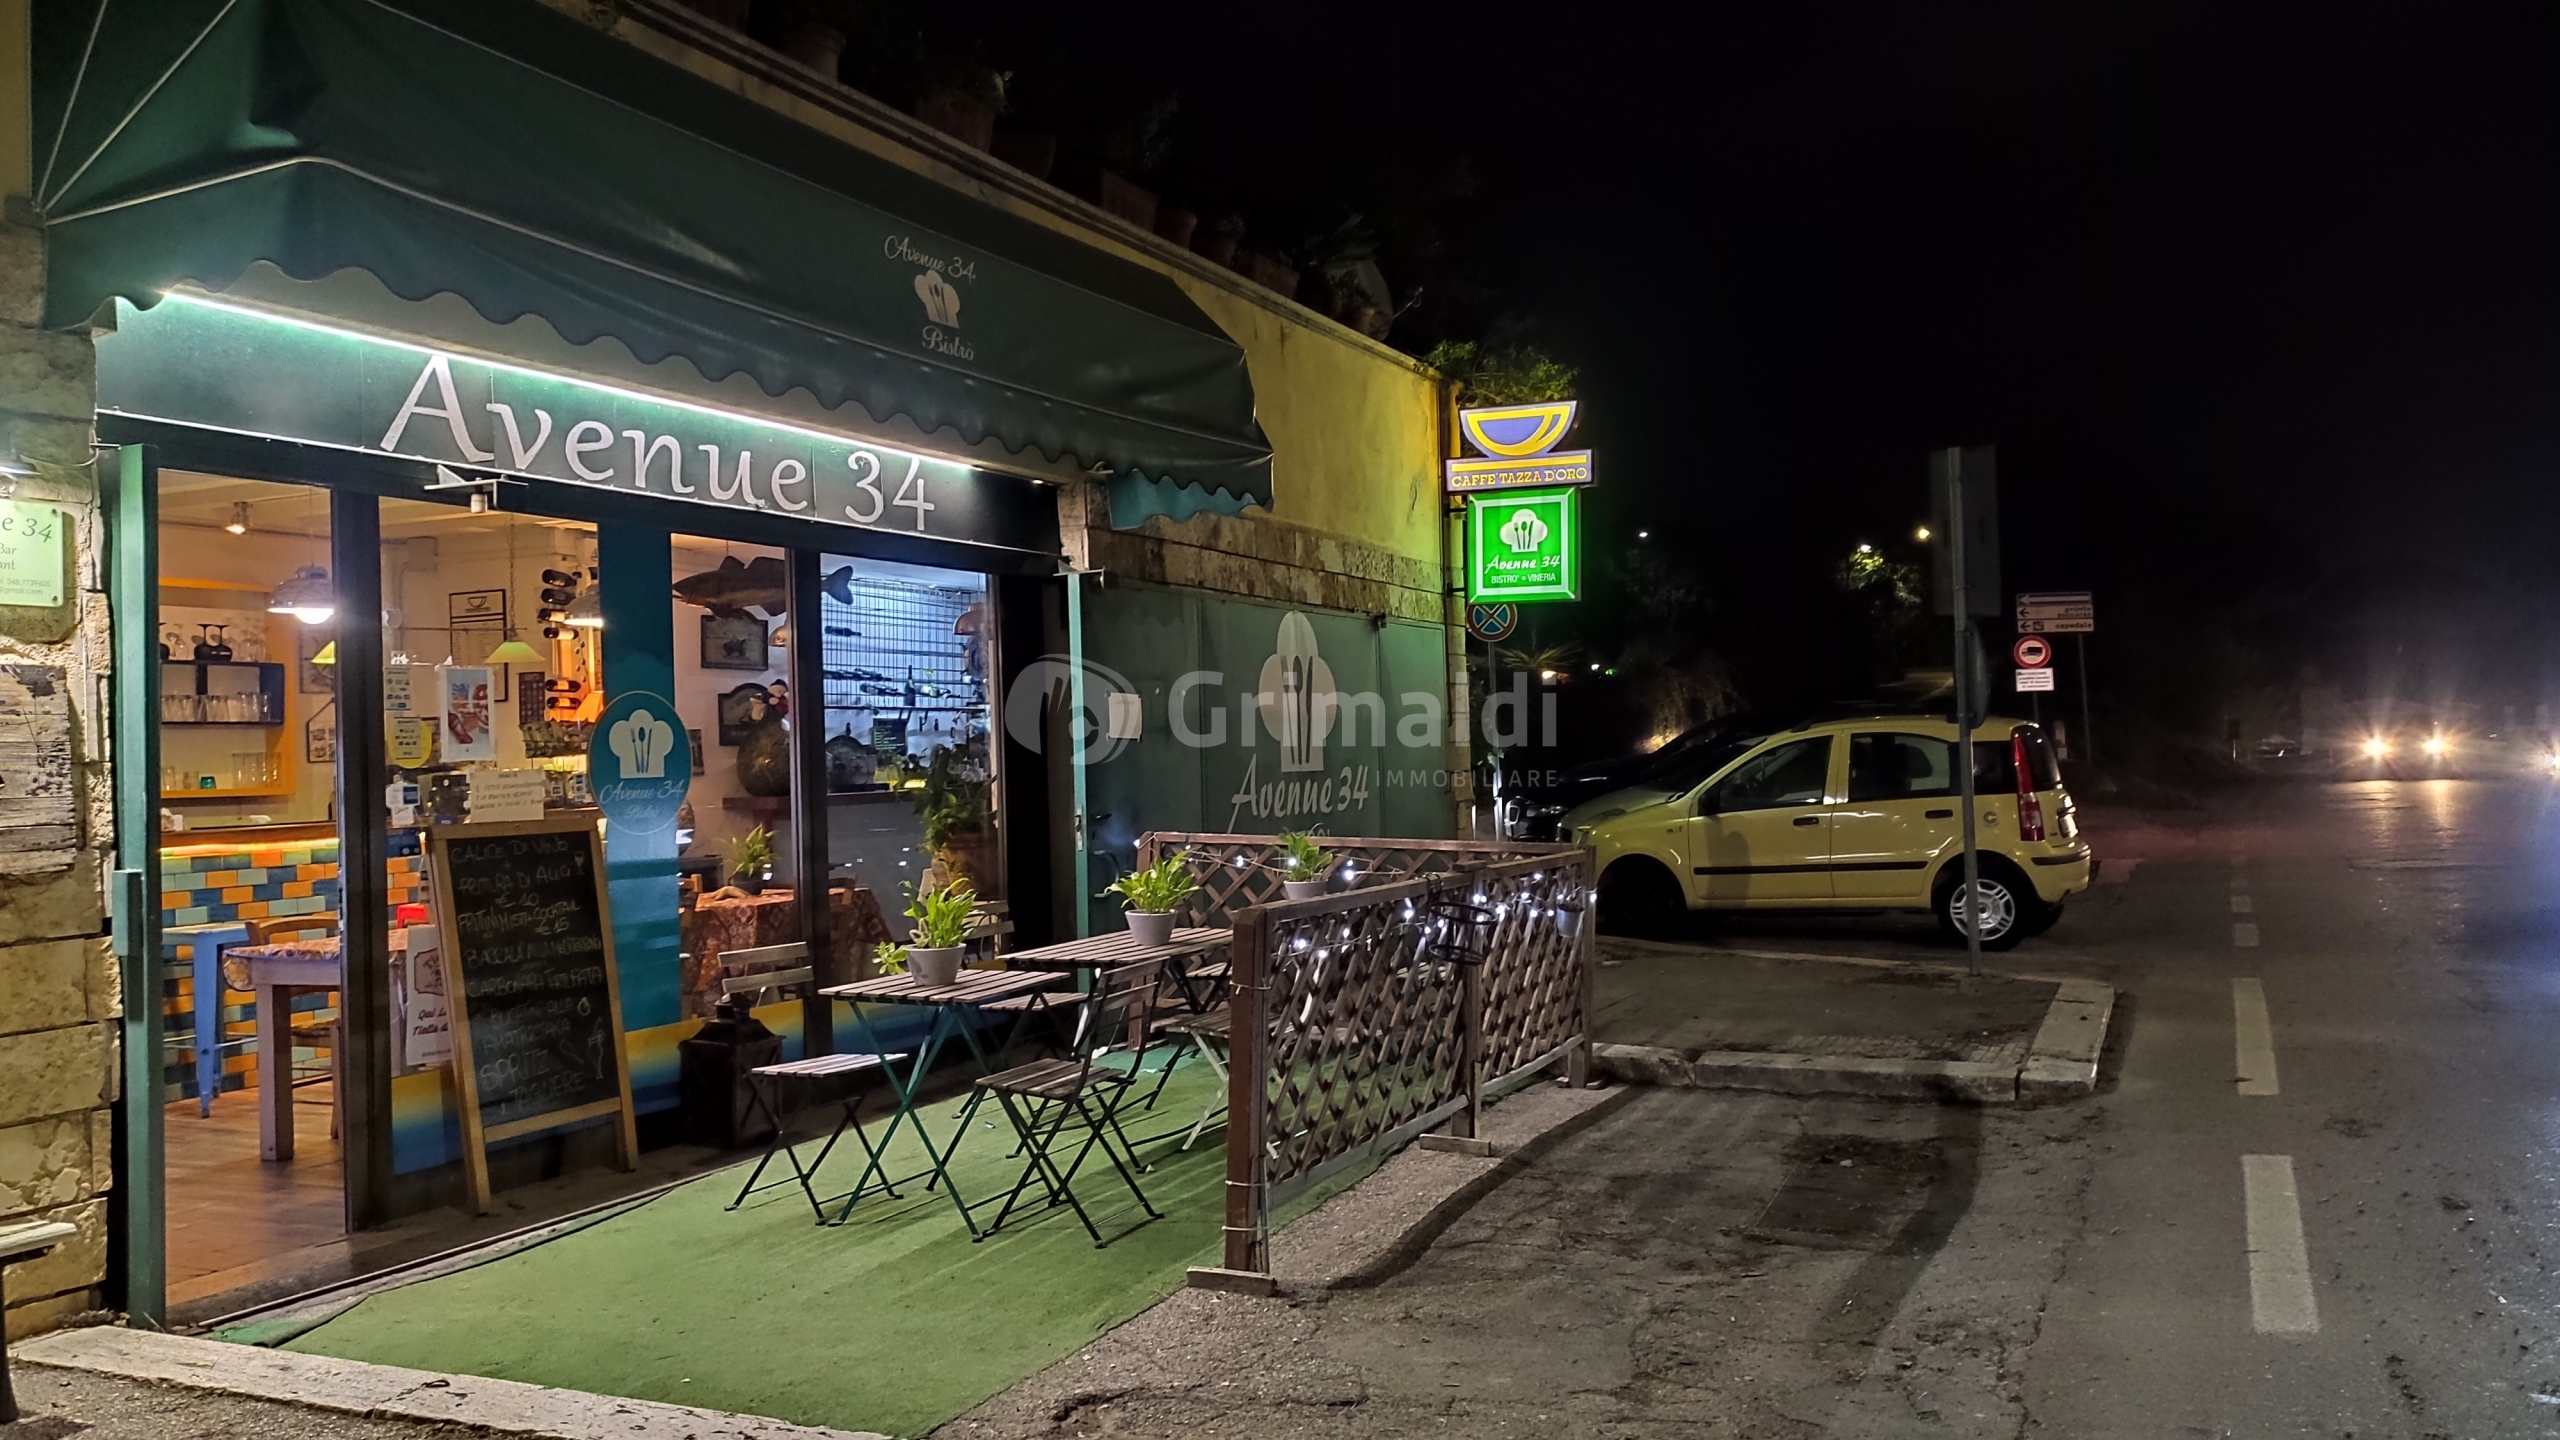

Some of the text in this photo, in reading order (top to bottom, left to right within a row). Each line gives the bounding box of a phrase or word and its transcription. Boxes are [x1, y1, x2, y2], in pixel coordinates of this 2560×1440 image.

[884, 235, 977, 284] Avenue 34
[379, 354, 935, 531] Avenue 34
[1499, 470, 1542, 485] TAZZA
[1544, 468, 1588, 482] D'ORO
[22, 517, 53, 544] 34
[1484, 554, 1561, 575] Avenue 34
[1528, 573, 1557, 583] VINERIA
[2055, 621, 2093, 630] ospedale
[599, 778, 685, 804] Avenue 34
[1226, 753, 1369, 834] Avenue 34
[451, 836, 569, 863] CALICE DI VINO
[519, 893, 540, 907] 10
[533, 900, 581, 920] COCKTAIL
[553, 917, 570, 934] 15
[480, 1049, 550, 1091] SPRITZ
